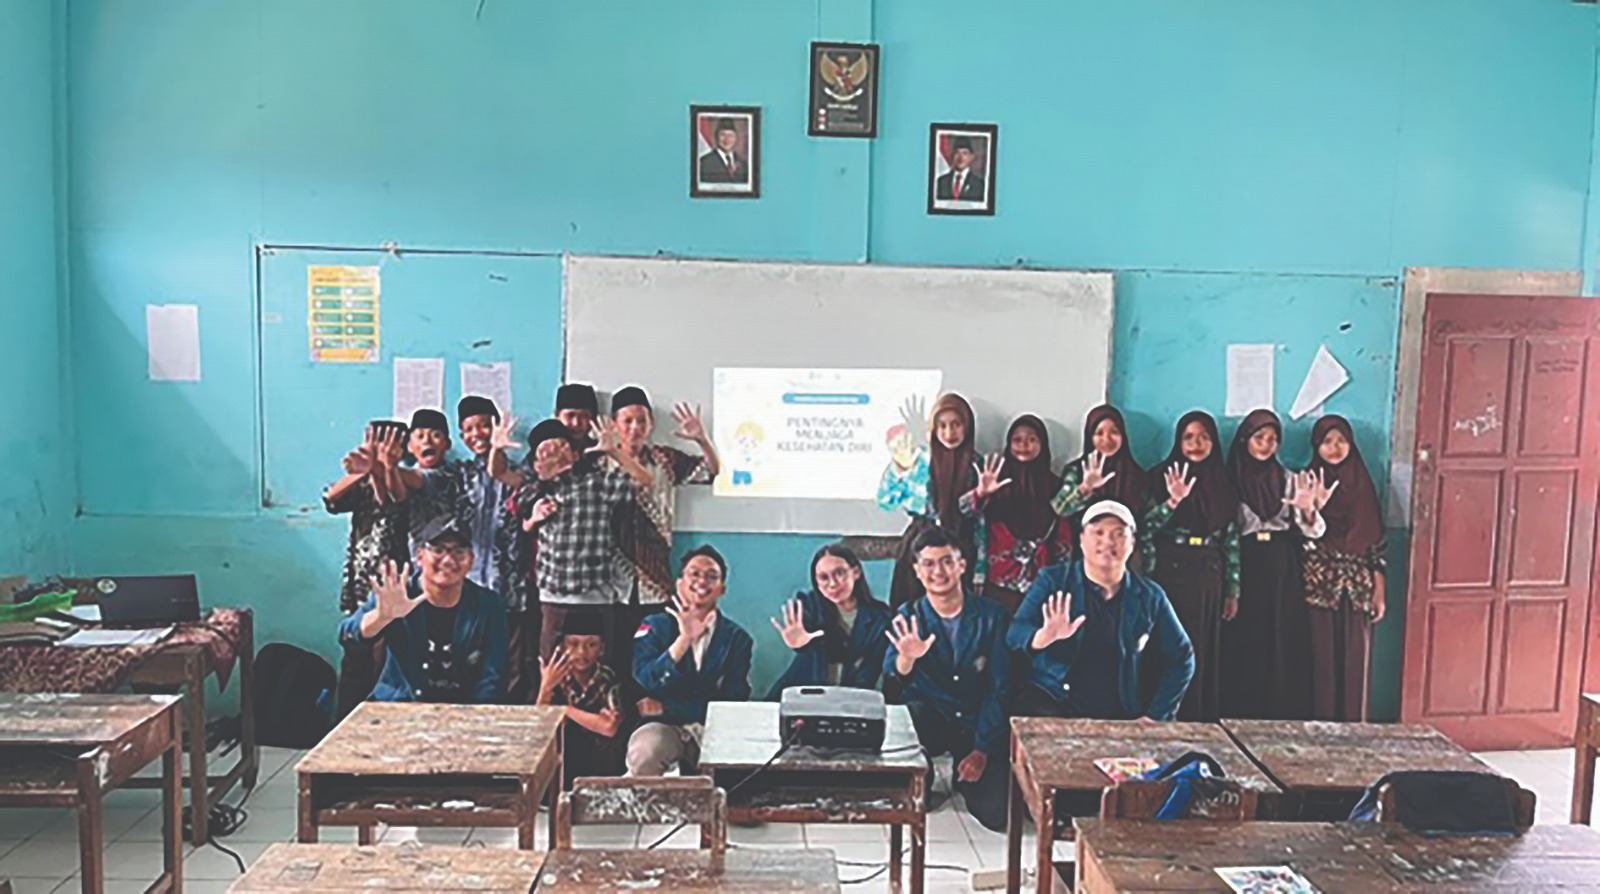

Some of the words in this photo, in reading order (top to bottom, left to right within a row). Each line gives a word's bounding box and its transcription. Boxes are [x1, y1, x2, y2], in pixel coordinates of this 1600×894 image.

[786, 417, 864, 428] PENTINGNYA
[795, 429, 854, 440] MENJAGA
[776, 441, 844, 452] KESEHATAN
